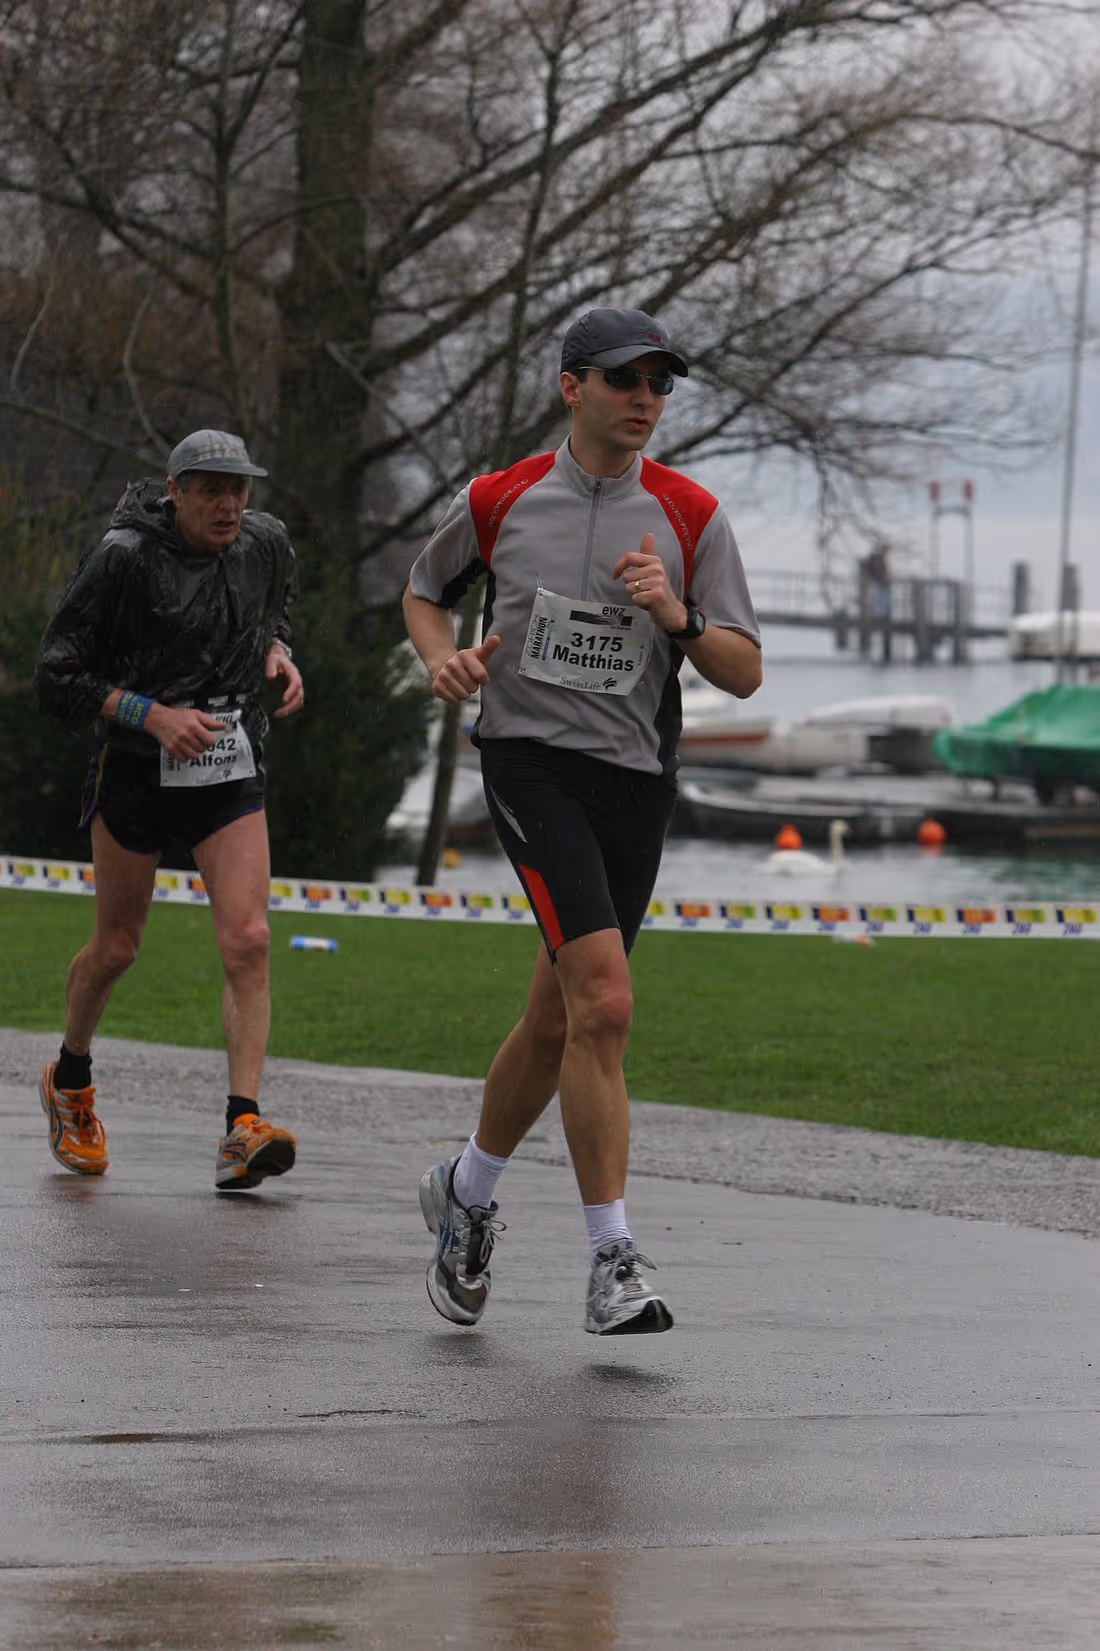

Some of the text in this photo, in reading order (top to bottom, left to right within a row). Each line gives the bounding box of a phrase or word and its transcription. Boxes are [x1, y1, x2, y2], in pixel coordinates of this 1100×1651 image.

[602, 606, 626, 616] ewz
[531, 616, 548, 659] MARATHON
[571, 632, 623, 652] 3175
[552, 644, 634, 671] Matthias
[189, 754, 237, 767] Alfons
